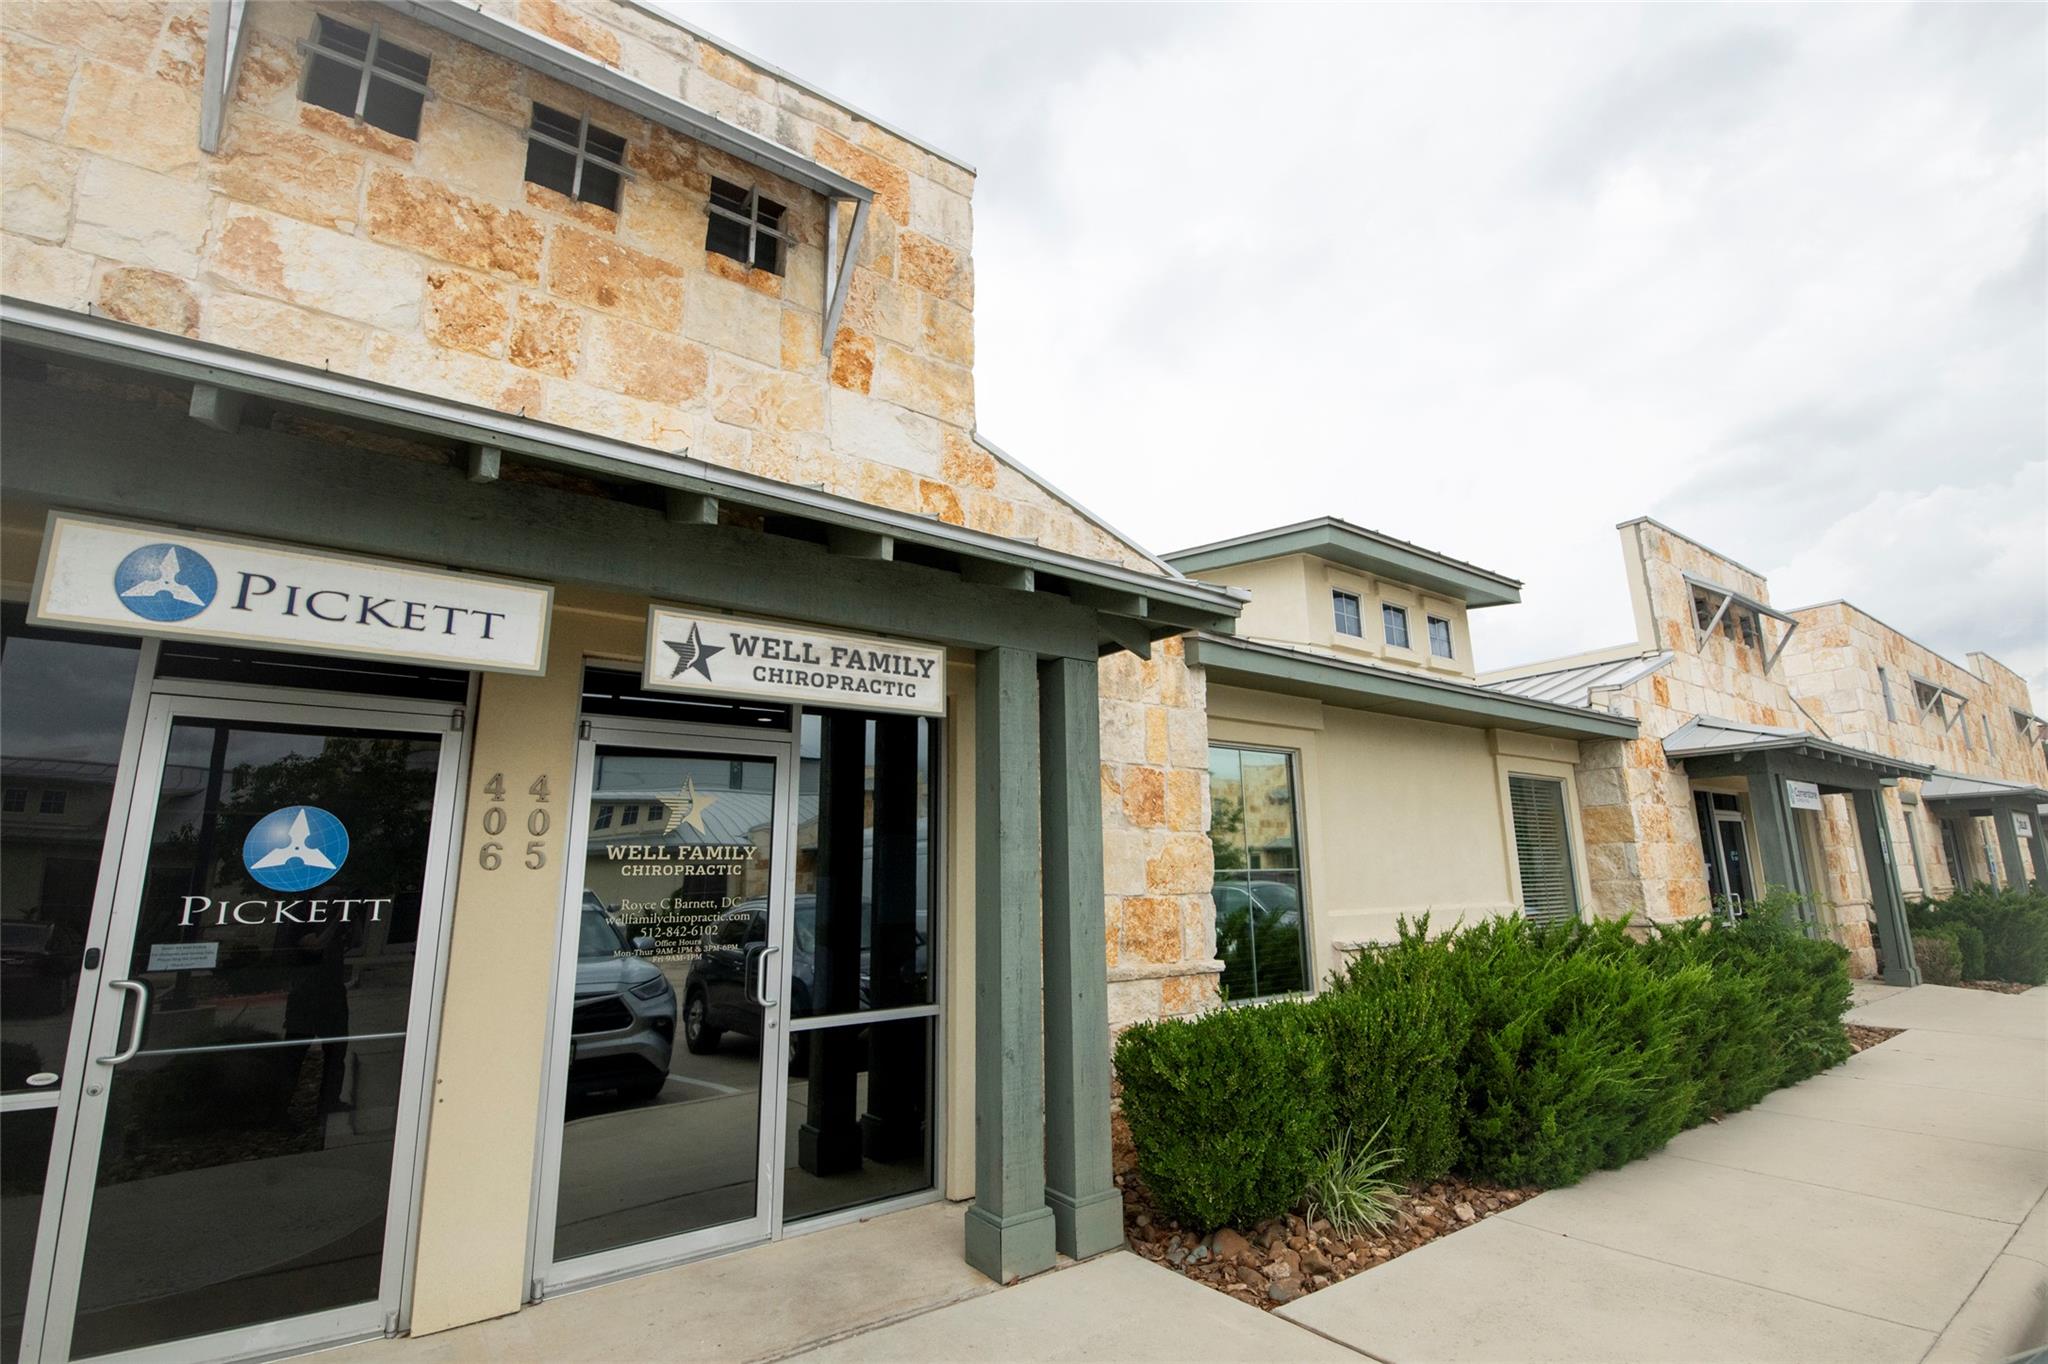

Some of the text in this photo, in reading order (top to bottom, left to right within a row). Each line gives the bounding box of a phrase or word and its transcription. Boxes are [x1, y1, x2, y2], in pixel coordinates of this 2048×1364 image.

[730, 632, 936, 679] WELL FAMILY
[752, 665, 917, 698] CHIROPRACTIC
[606, 845, 758, 861] WELL FAMILY
[621, 864, 742, 877] CHIROPRACTIC
[621, 896, 742, 913] Royce C Barnett, DC
[605, 911, 751, 927] wellfamilychiropractic.com
[640, 925, 719, 938] 512-842-6102
[655, 939, 702, 947] Office Hours
[613, 948, 654, 958] Mon-Thur
[655, 946, 693, 955] 9AM-1PM
